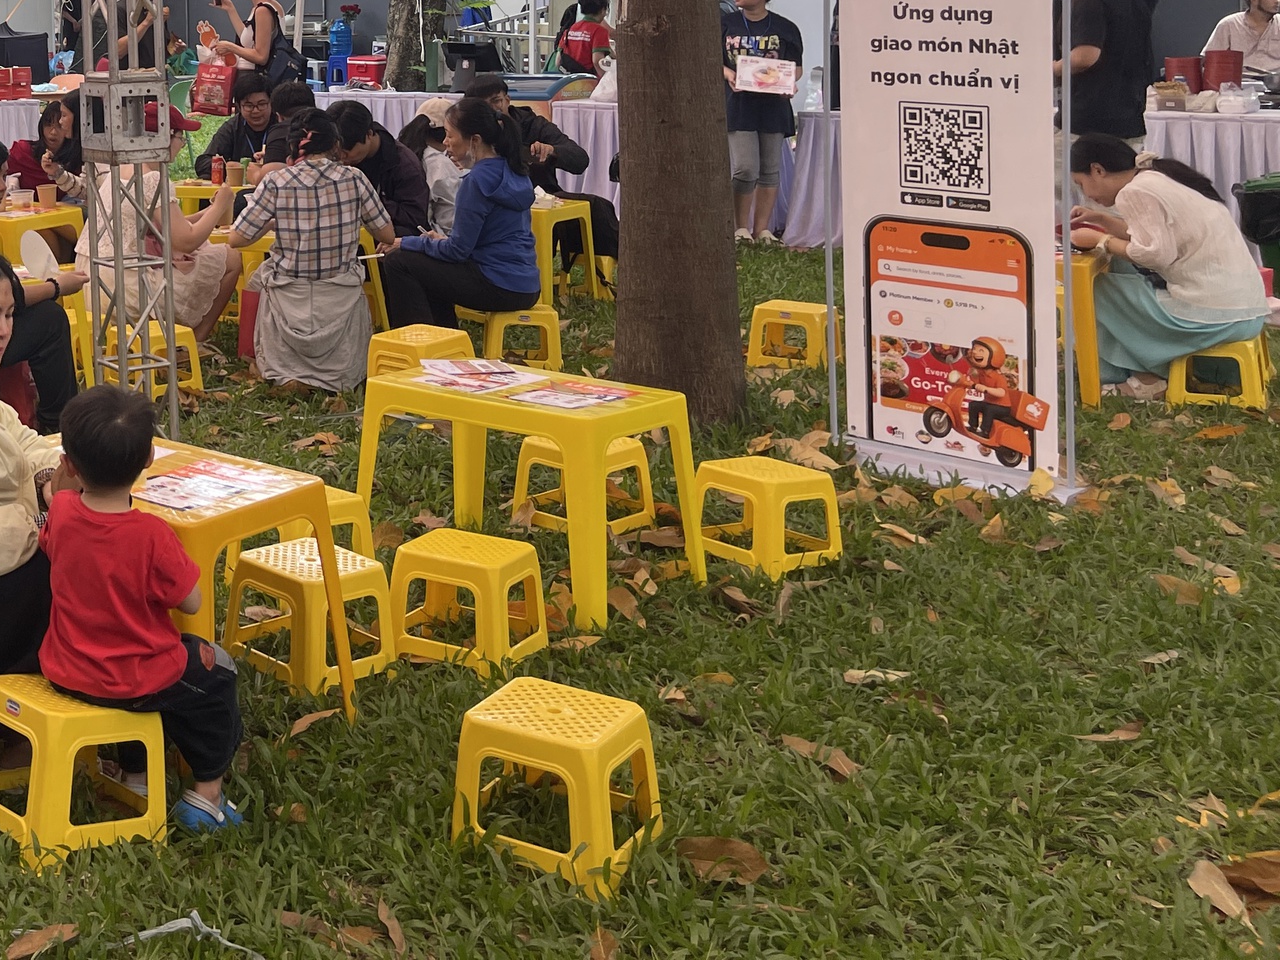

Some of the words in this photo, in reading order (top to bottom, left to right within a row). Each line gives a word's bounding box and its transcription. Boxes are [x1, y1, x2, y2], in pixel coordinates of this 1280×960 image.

[893, 1, 934, 23] Ứng
[940, 6, 993, 25] dụng
[870, 36, 913, 54] giao
[918, 36, 963, 53] món
[969, 38, 1019, 58] Nhật
[870, 70, 921, 87] ngon
[928, 68, 993, 89] chuẩn
[1000, 74, 1020, 93] vị
[925, 367, 948, 378] Every
